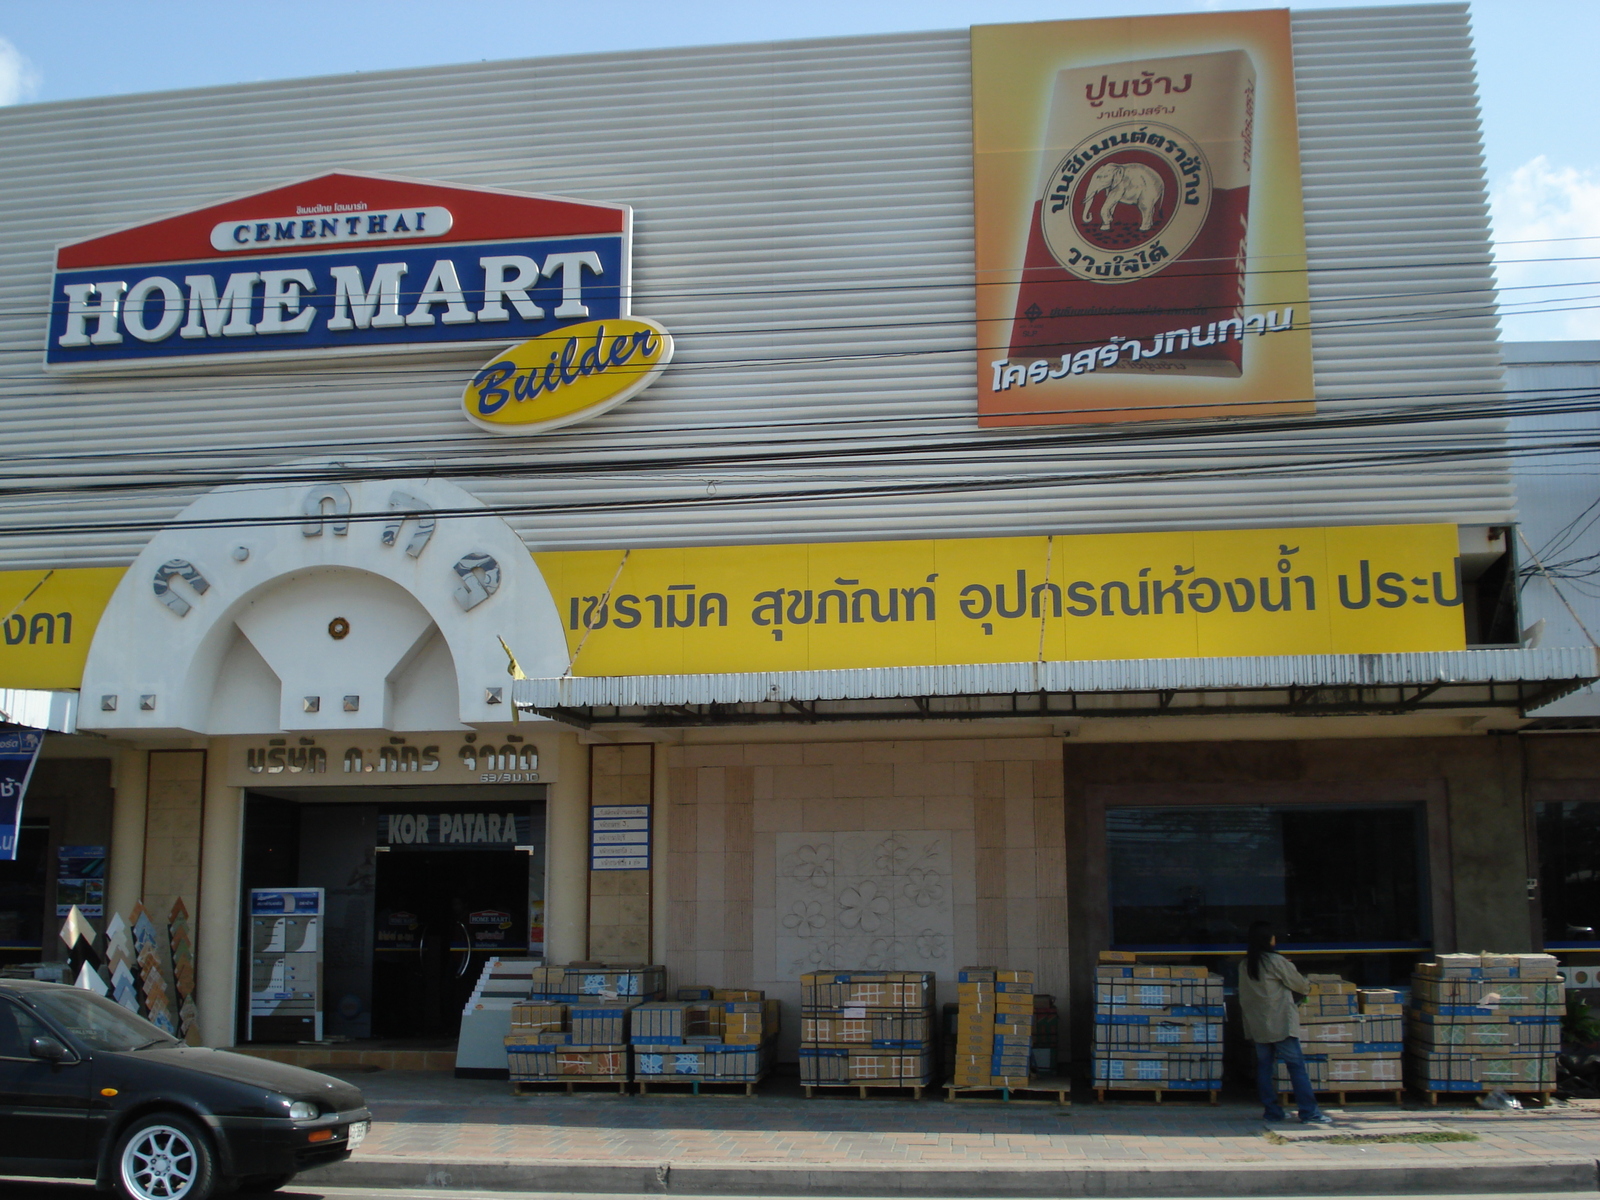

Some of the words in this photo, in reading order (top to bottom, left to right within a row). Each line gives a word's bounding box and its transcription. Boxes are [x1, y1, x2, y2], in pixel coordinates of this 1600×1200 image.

[1085, 70, 1193, 107] ปูนช้าง
[1096, 105, 1176, 120] งานโครงสร้าง
[233, 211, 426, 244] CEMENTHAI
[1068, 240, 1169, 276] วางใจได้
[59, 269, 317, 347] HOME
[326, 251, 604, 332] MART
[991, 307, 1294, 393] โครงสร้างทนทาน
[473, 324, 658, 416] Builder
[569, 584, 728, 630] เซรามิค
[751, 573, 939, 642] สุขภัณฑ์
[959, 544, 1316, 636] อุปกรณ์ห้องน้ำ
[247, 737, 327, 774] บริษัท
[458, 732, 539, 772] จำกัด
[388, 814, 430, 844] KOR
[439, 813, 518, 844] PATARA
